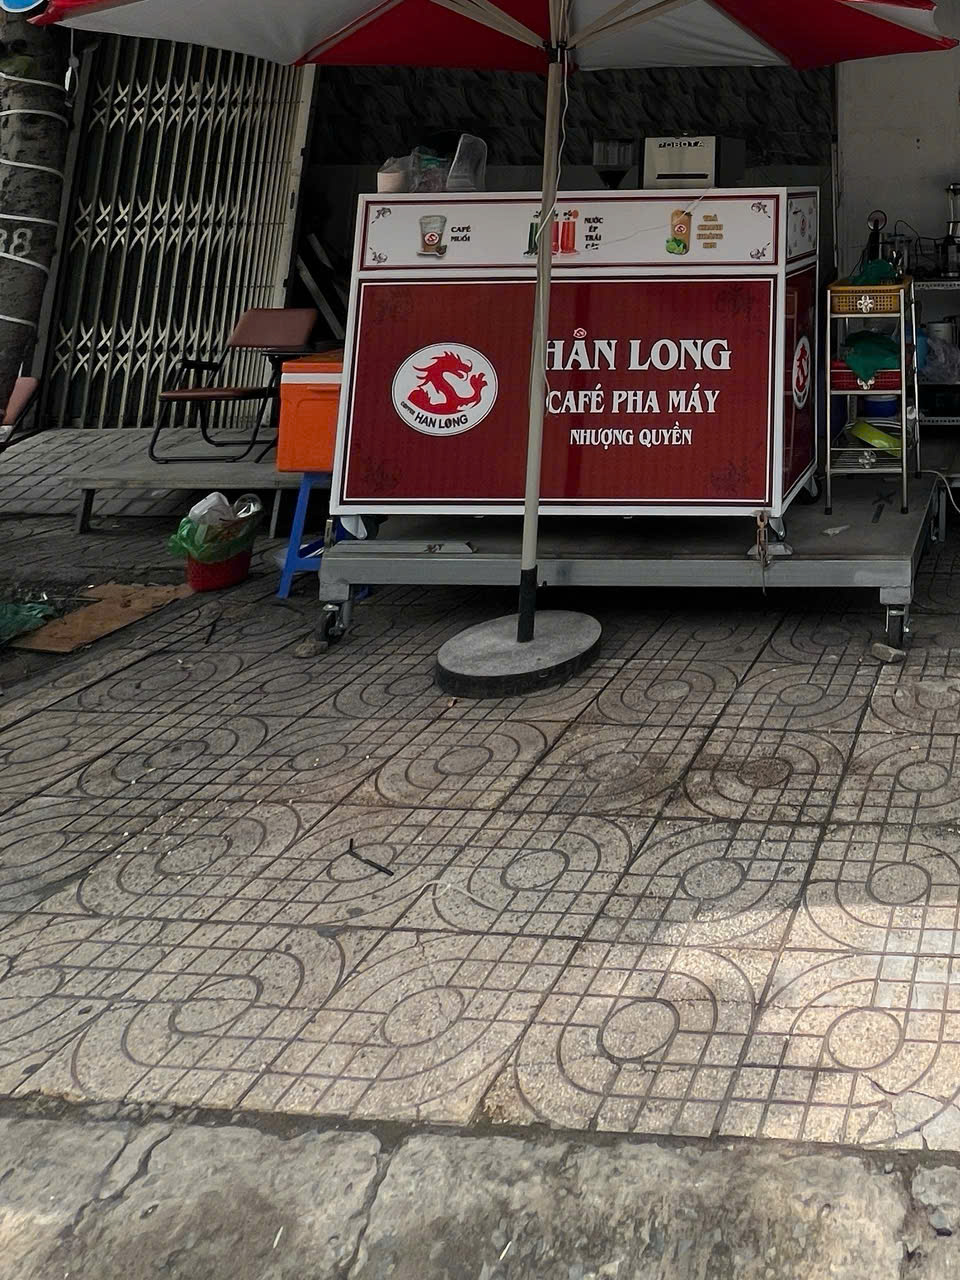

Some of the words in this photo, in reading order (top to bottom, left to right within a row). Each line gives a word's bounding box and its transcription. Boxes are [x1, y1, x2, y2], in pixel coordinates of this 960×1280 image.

[450, 224, 472, 233] CAFÉ
[627, 338, 732, 372] LONG
[546, 382, 606, 414] CAFÉ
[611, 389, 661, 414] PHA
[667, 382, 721, 414] MÁY
[414, 412, 437, 428] HAN
[438, 414, 469, 429] LONG
[569, 427, 635, 450] NHƯỢNG
[638, 420, 693, 446] QUYỀN
